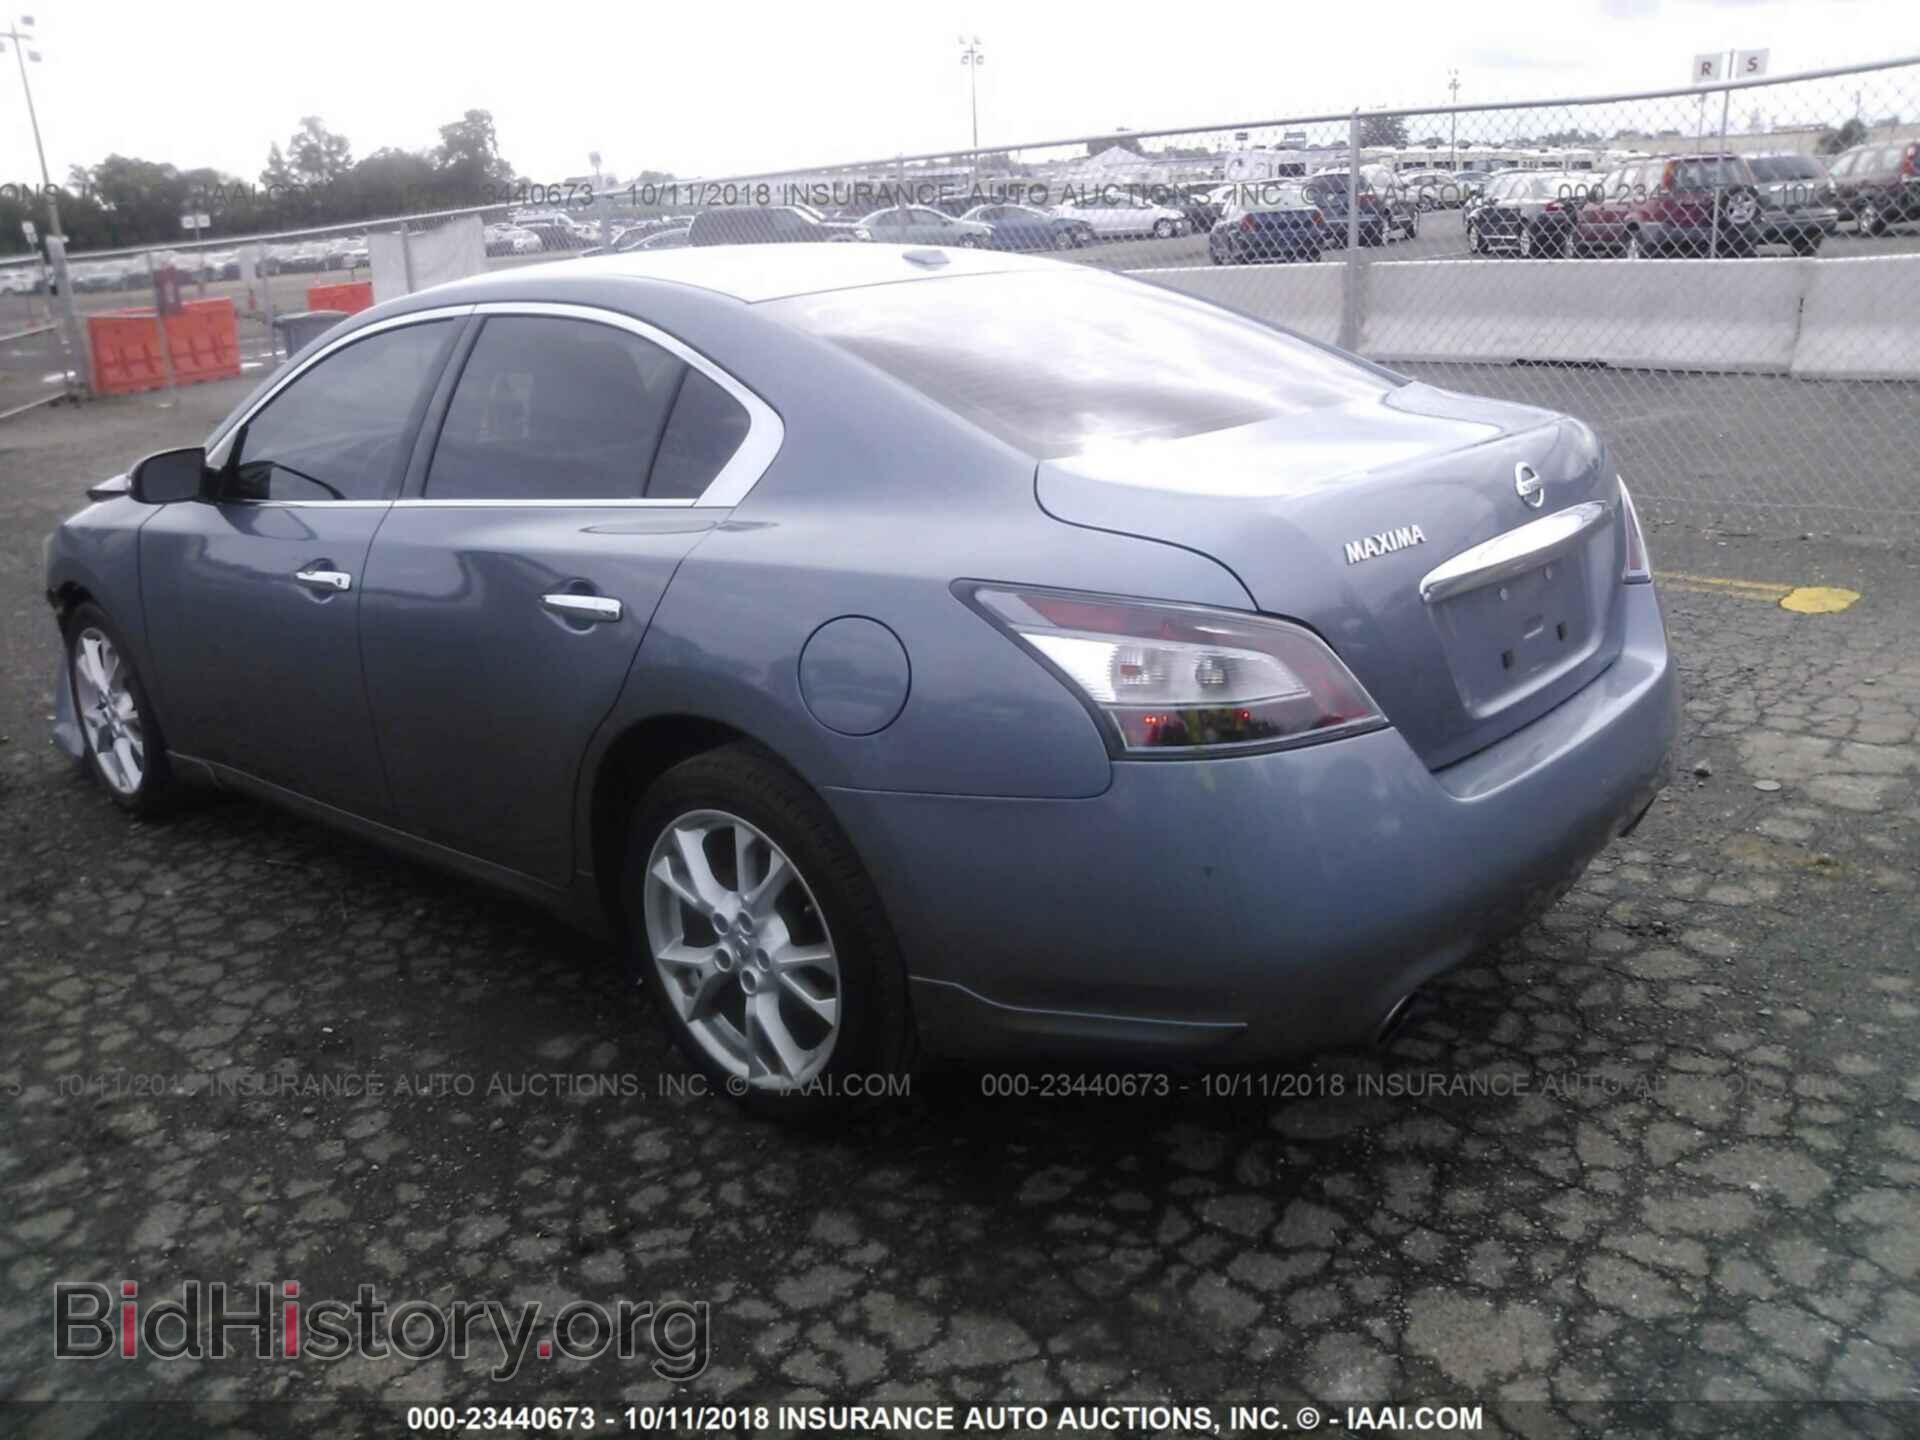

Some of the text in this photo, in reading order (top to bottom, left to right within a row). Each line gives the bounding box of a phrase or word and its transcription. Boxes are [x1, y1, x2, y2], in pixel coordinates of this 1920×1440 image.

[1700, 61, 1713, 76] R
[1745, 56, 1759, 72] S
[1344, 524, 1428, 565] MAXIMA
